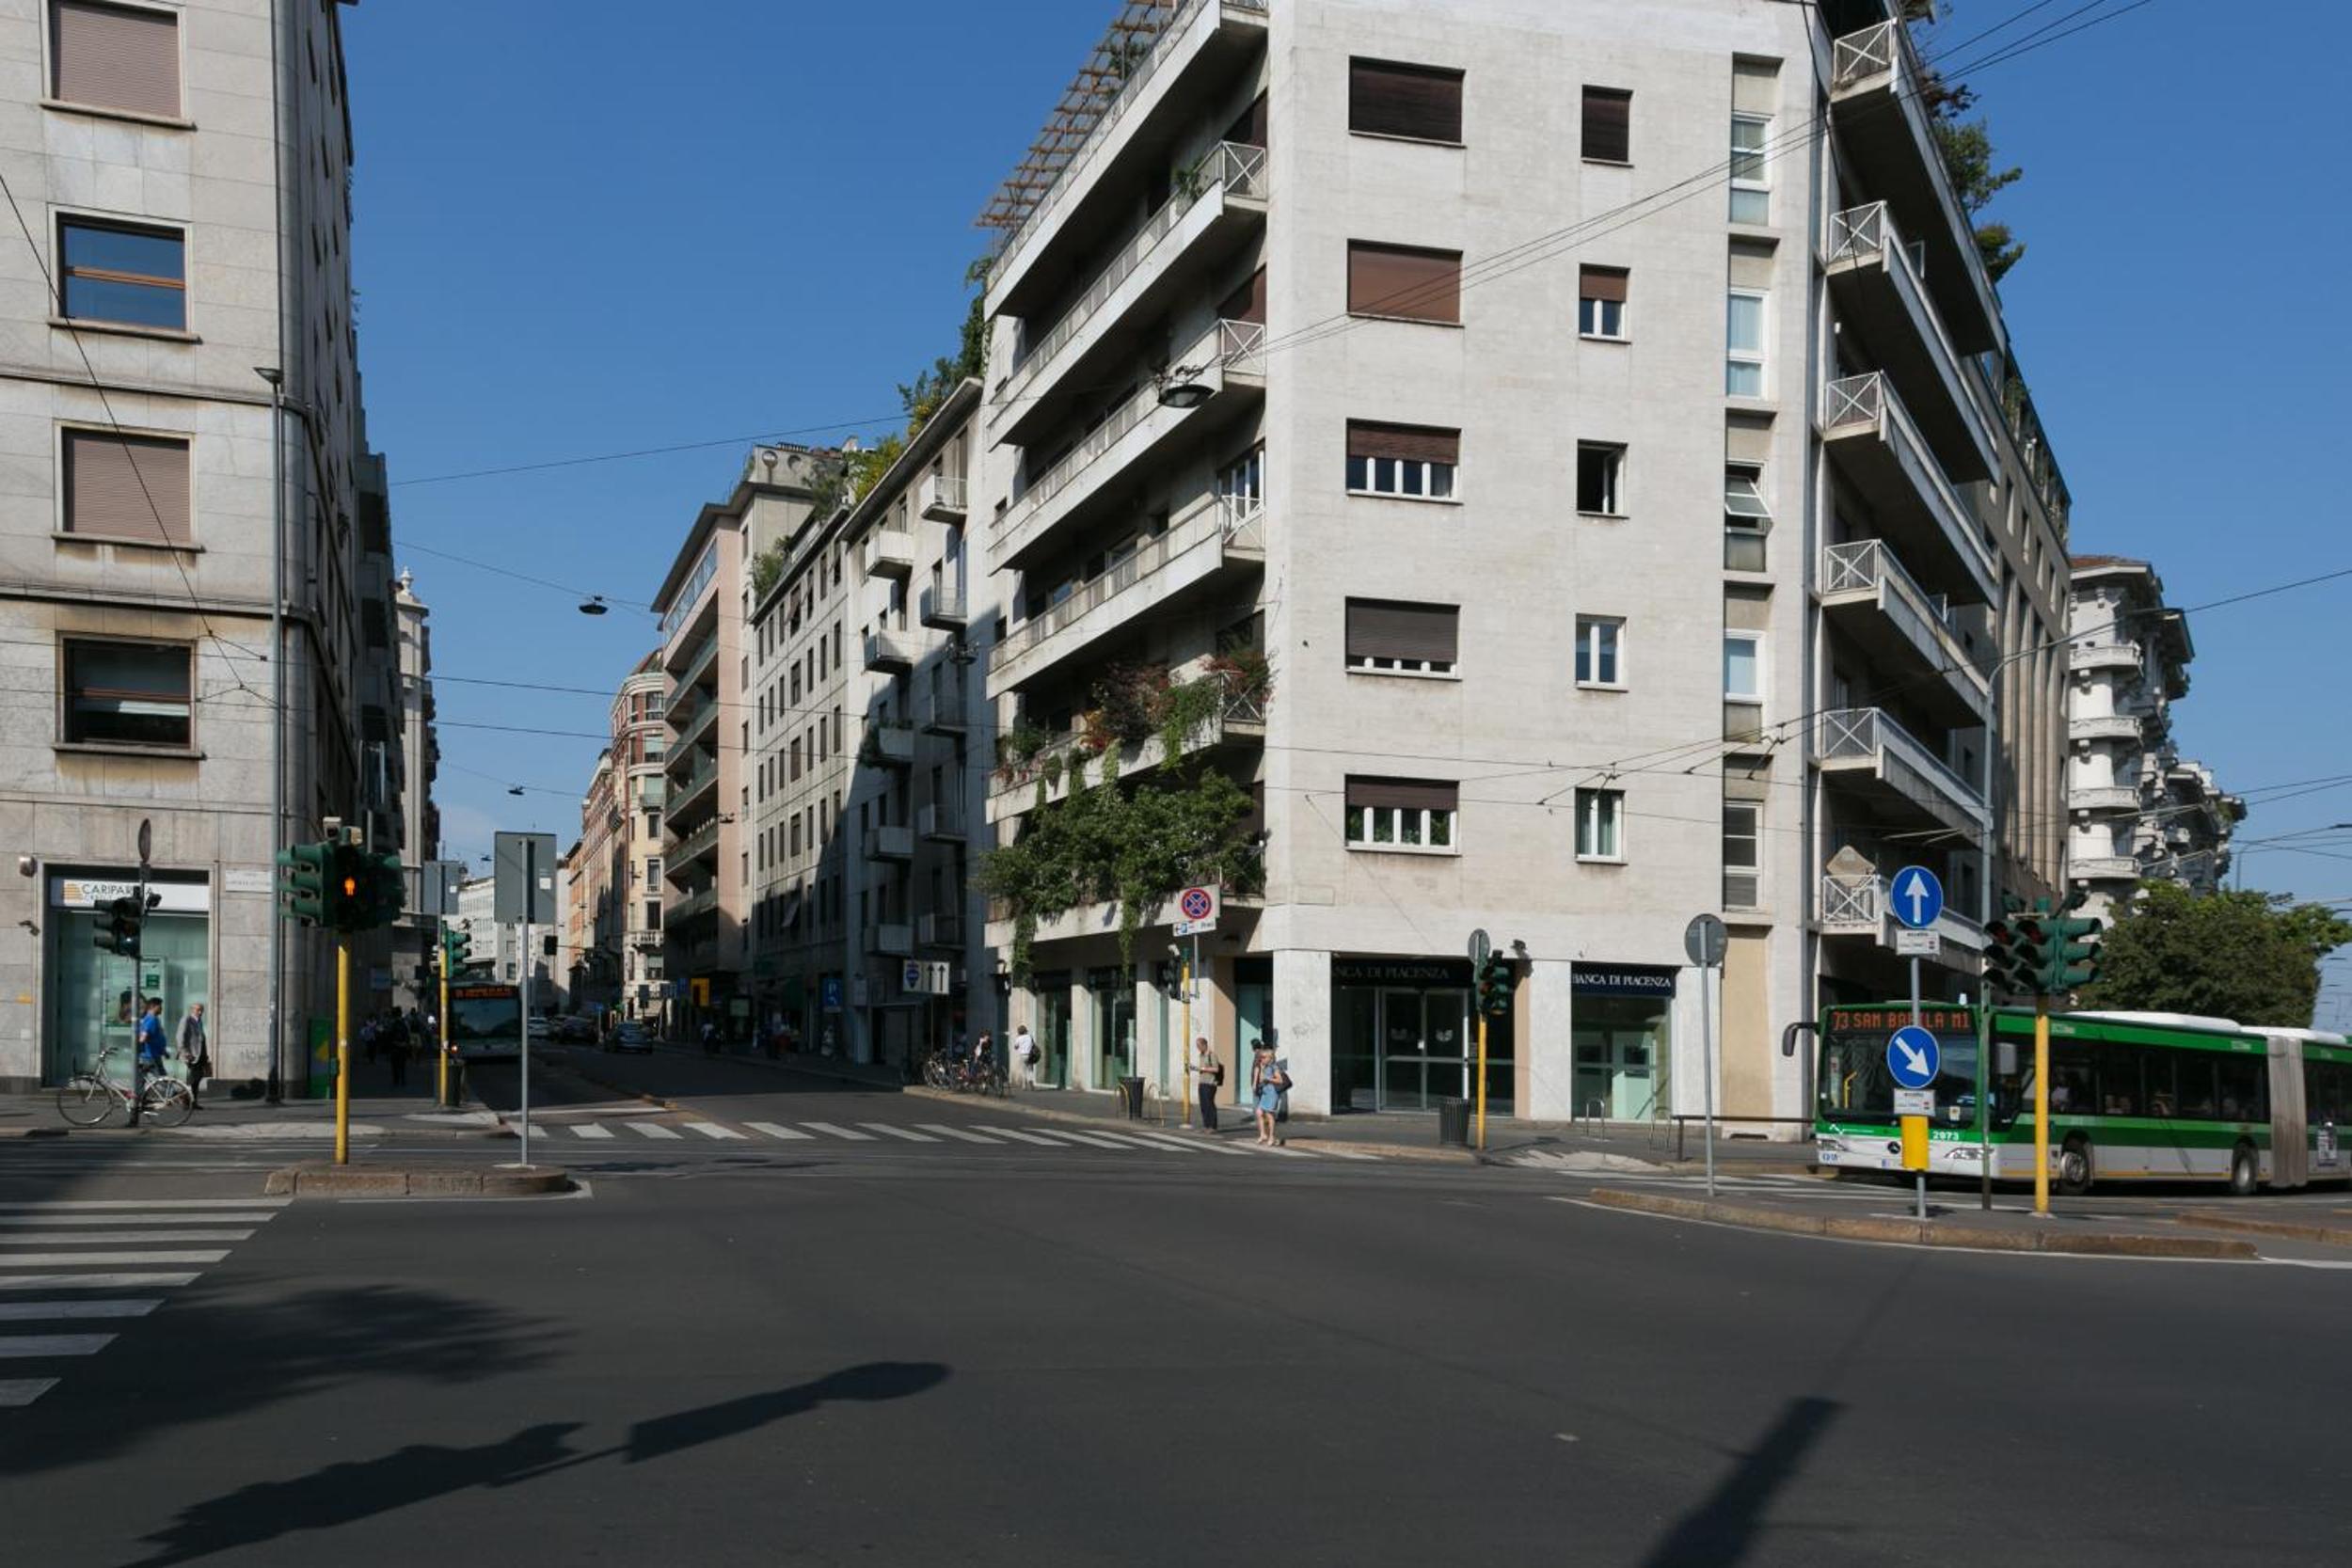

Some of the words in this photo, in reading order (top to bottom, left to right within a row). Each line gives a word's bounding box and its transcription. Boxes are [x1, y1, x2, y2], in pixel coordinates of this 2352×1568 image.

[81, 882, 152, 895] CARIPARA
[1610, 974, 1621, 986] DI
[1624, 975, 1671, 988] PIACENZA
[1833, 1011, 1850, 1031] 73
[1888, 1011, 1944, 1030] BALA
